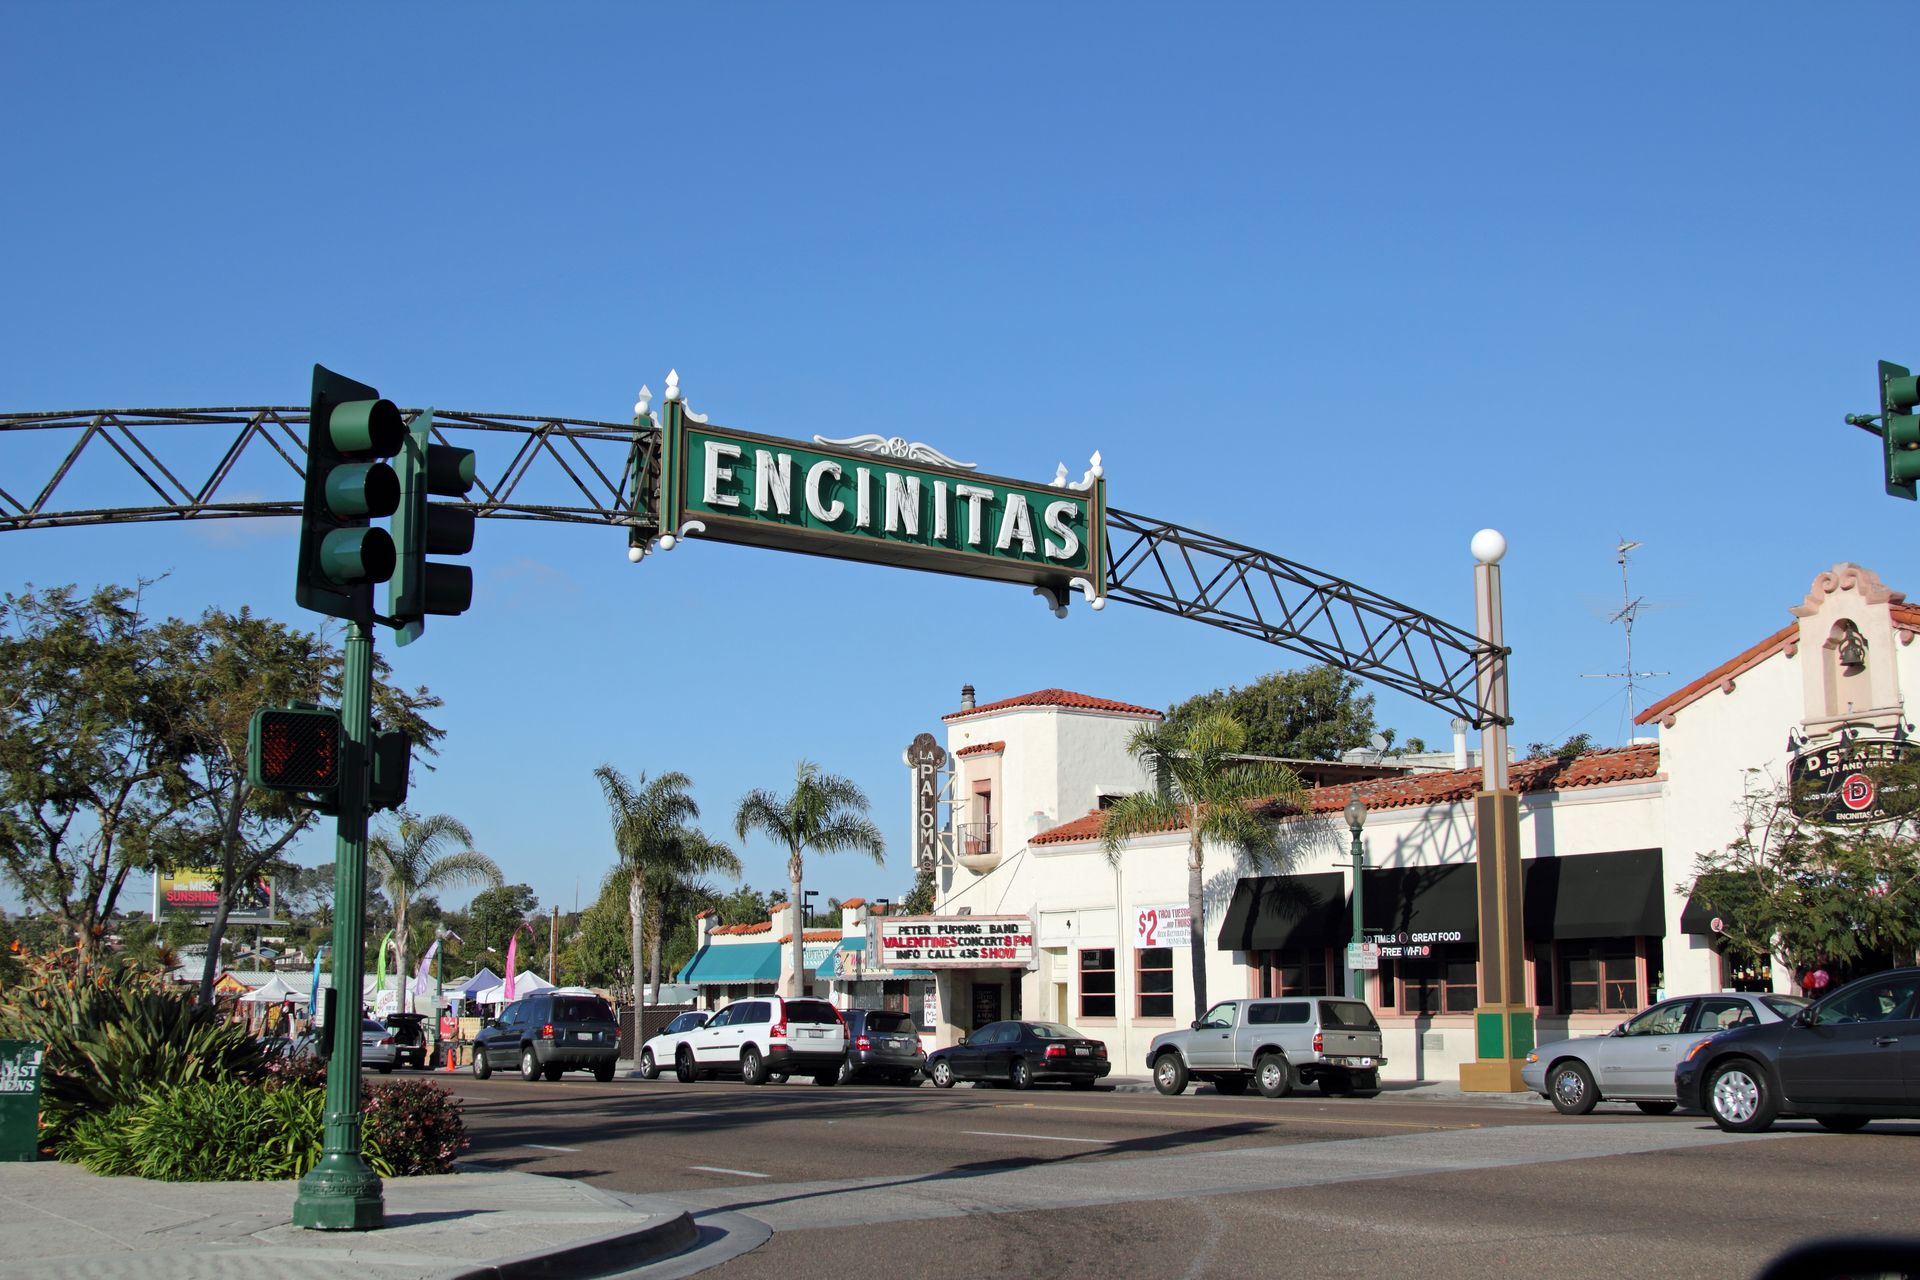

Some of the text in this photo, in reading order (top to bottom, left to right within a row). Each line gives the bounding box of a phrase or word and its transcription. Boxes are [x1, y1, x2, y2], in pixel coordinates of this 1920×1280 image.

[703, 440, 1080, 560] ENCINITAS
[920, 750, 934, 761] LA
[1807, 755, 1821, 772] D
[1819, 765, 1840, 777] BAR
[1842, 761, 1863, 771] AND
[1848, 781, 1868, 802] D
[920, 764, 935, 860] PALOMA
[1873, 809, 1885, 817] CA
[166, 891, 220, 903] SUNSHINE
[898, 923, 1019, 935] PETER PUPPING BAND
[1138, 909, 1158, 946] $2
[882, 936, 958, 948] VALENTINES
[958, 936, 1004, 946] CONCERT
[1373, 934, 1396, 944] TIMES
[1411, 932, 1437, 943] GREAT
[1438, 931, 1461, 942] FOOD
[896, 949, 921, 960] INFO
[927, 949, 955, 959] CALL
[980, 947, 1016, 959] SHOW
[1381, 946, 1402, 957] FREE
